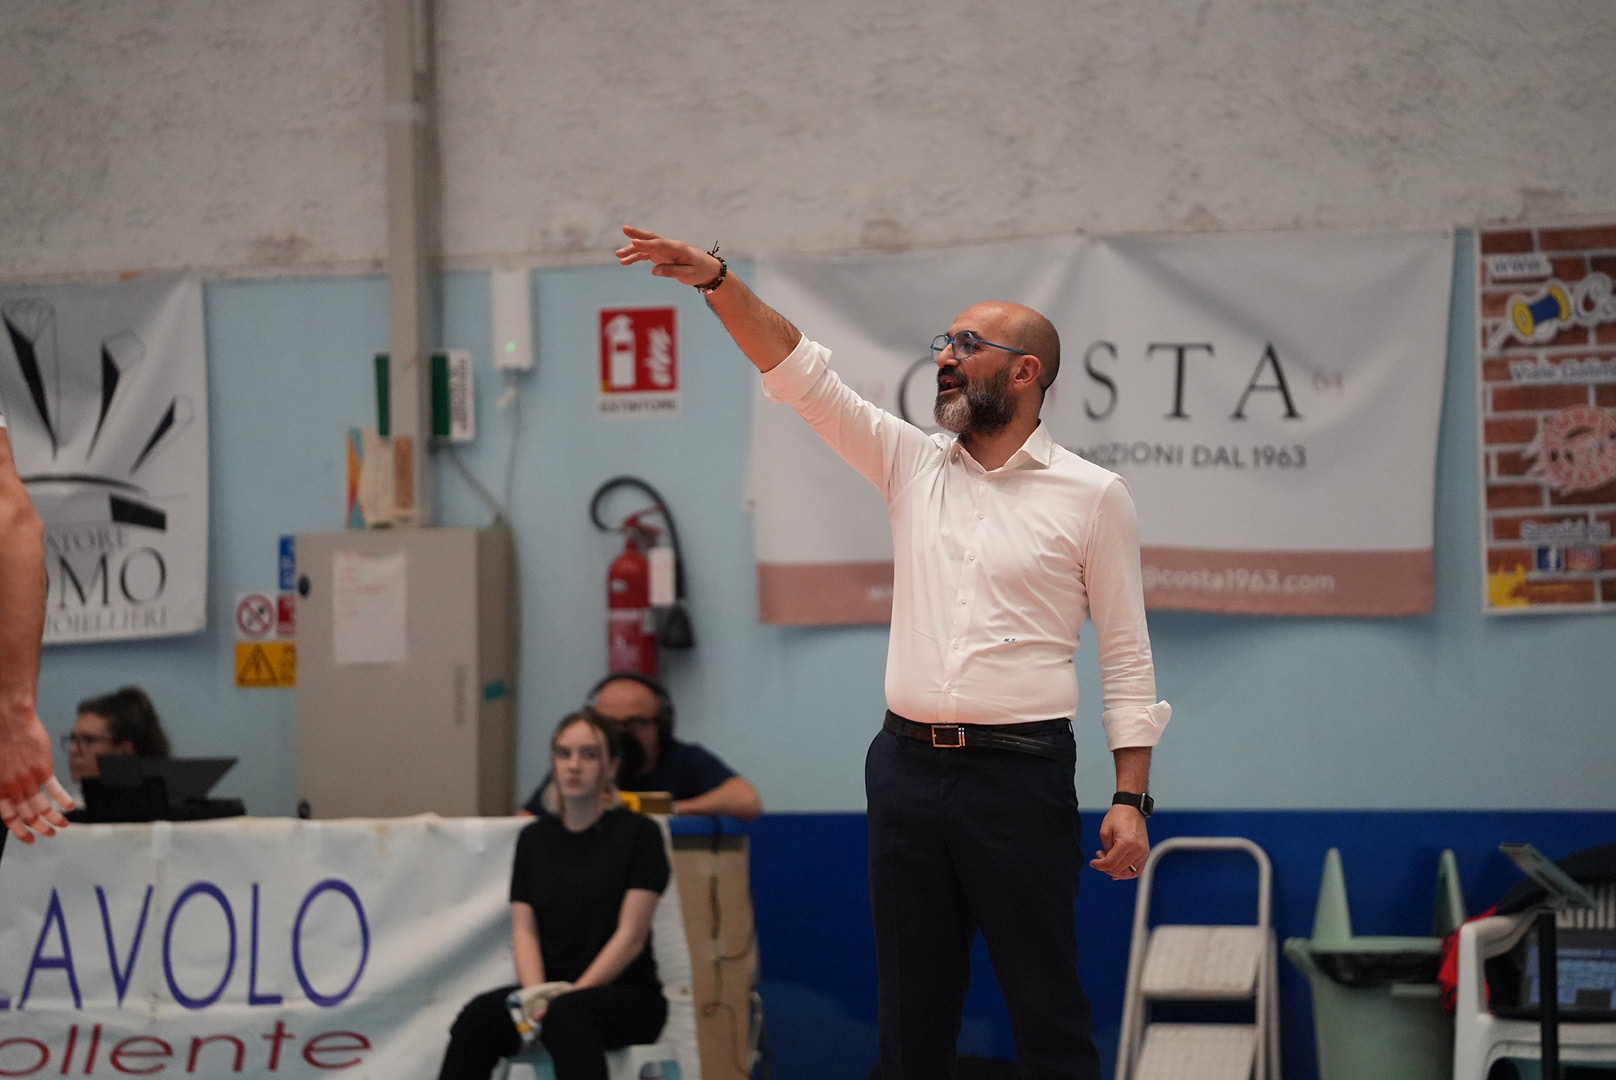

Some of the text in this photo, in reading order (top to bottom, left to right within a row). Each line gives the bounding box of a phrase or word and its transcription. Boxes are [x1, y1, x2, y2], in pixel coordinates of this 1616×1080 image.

[896, 339, 1303, 433] CSTA
[1191, 444, 1246, 469] DAL
[1252, 443, 1307, 468] 1963
[45, 546, 167, 610] MO
